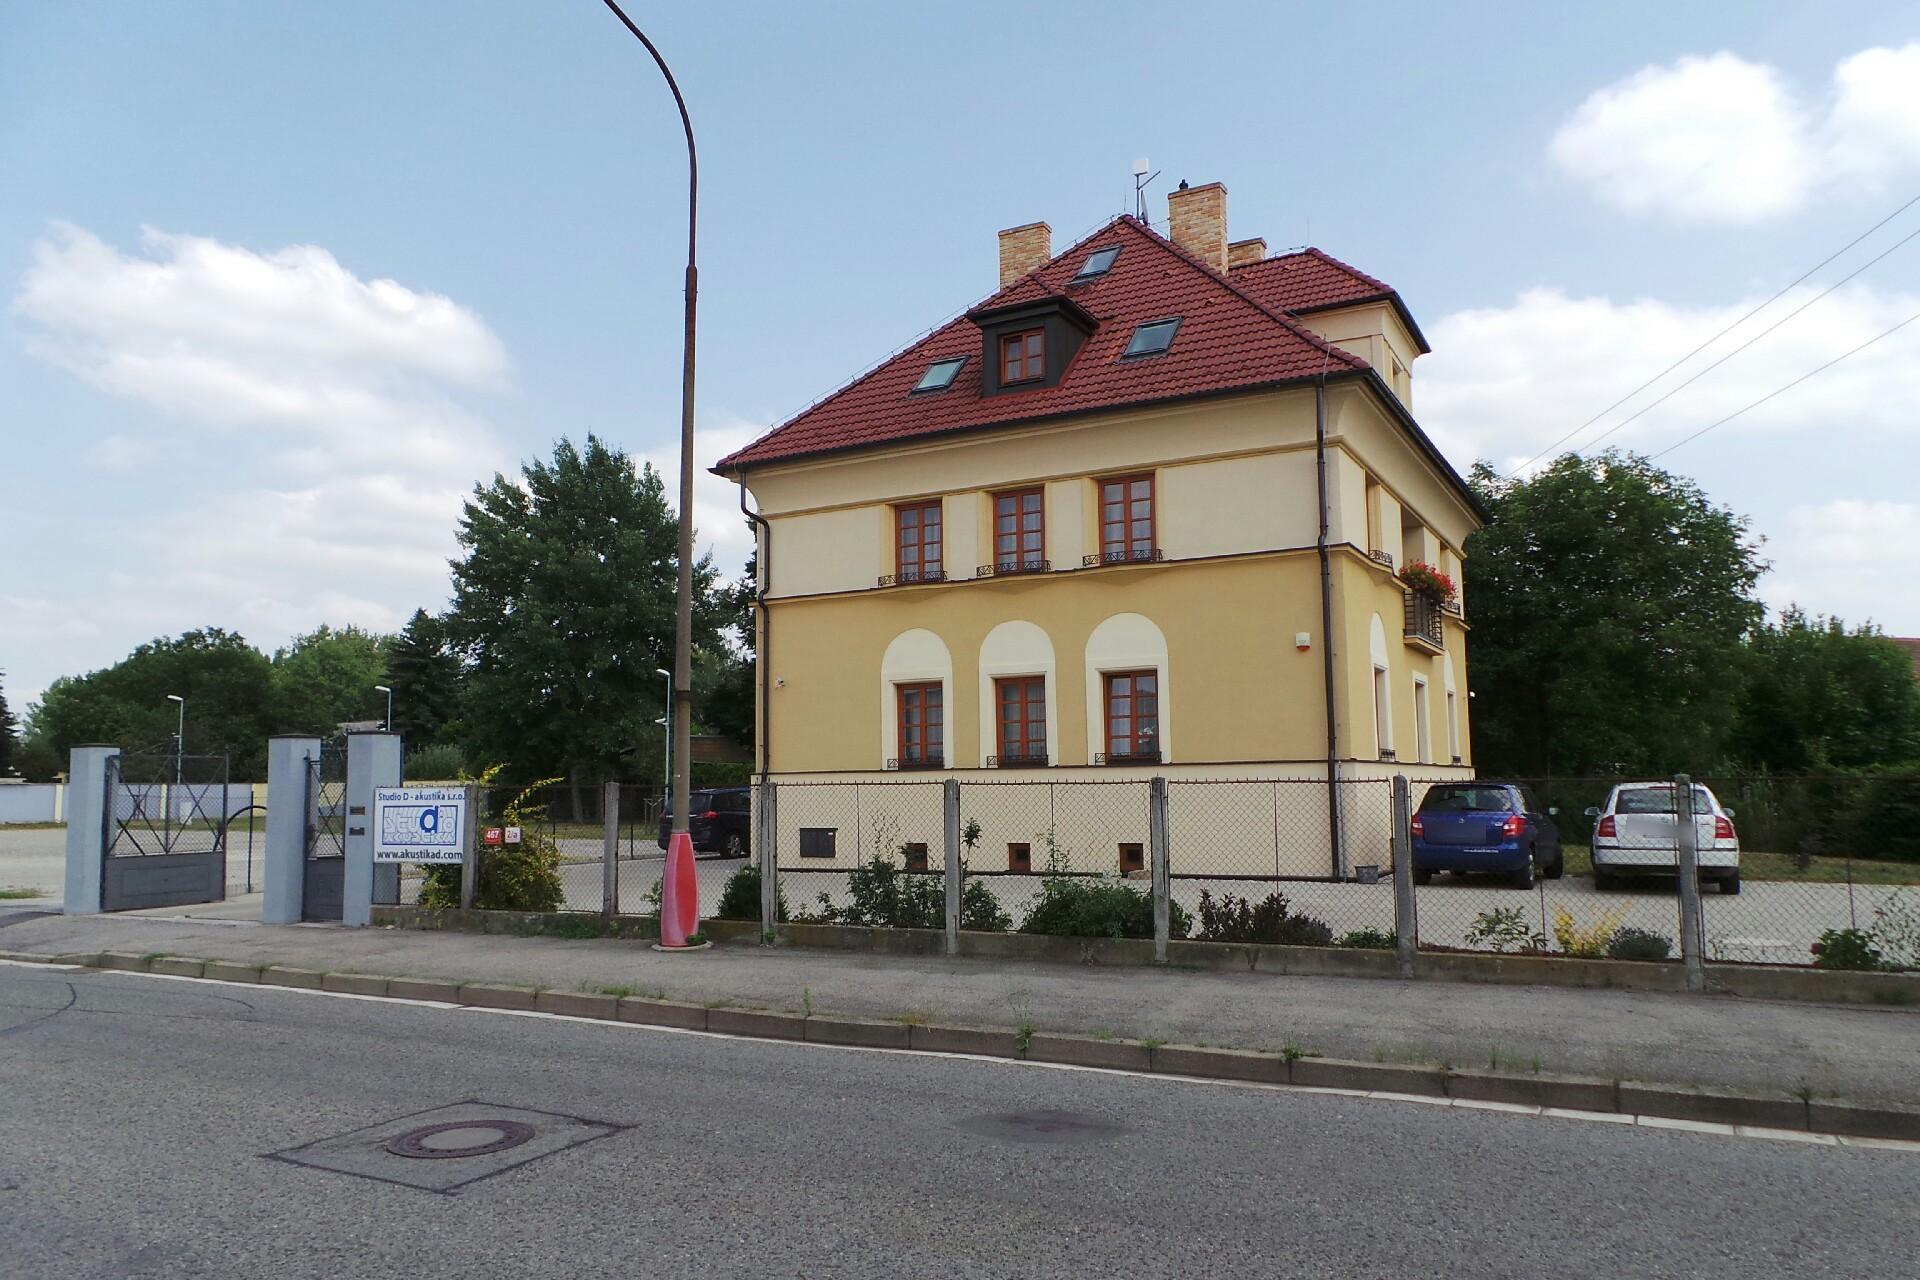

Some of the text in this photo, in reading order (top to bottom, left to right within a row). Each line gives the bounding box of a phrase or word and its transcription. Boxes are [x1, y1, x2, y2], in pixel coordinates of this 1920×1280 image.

[378, 792, 401, 801] Studio
[403, 792, 409, 801] D
[415, 792, 445, 801] akustika
[447, 793, 465, 801] s.r.o.
[486, 830, 499, 839] 467
[376, 848, 463, 860] www.akustikad.com
